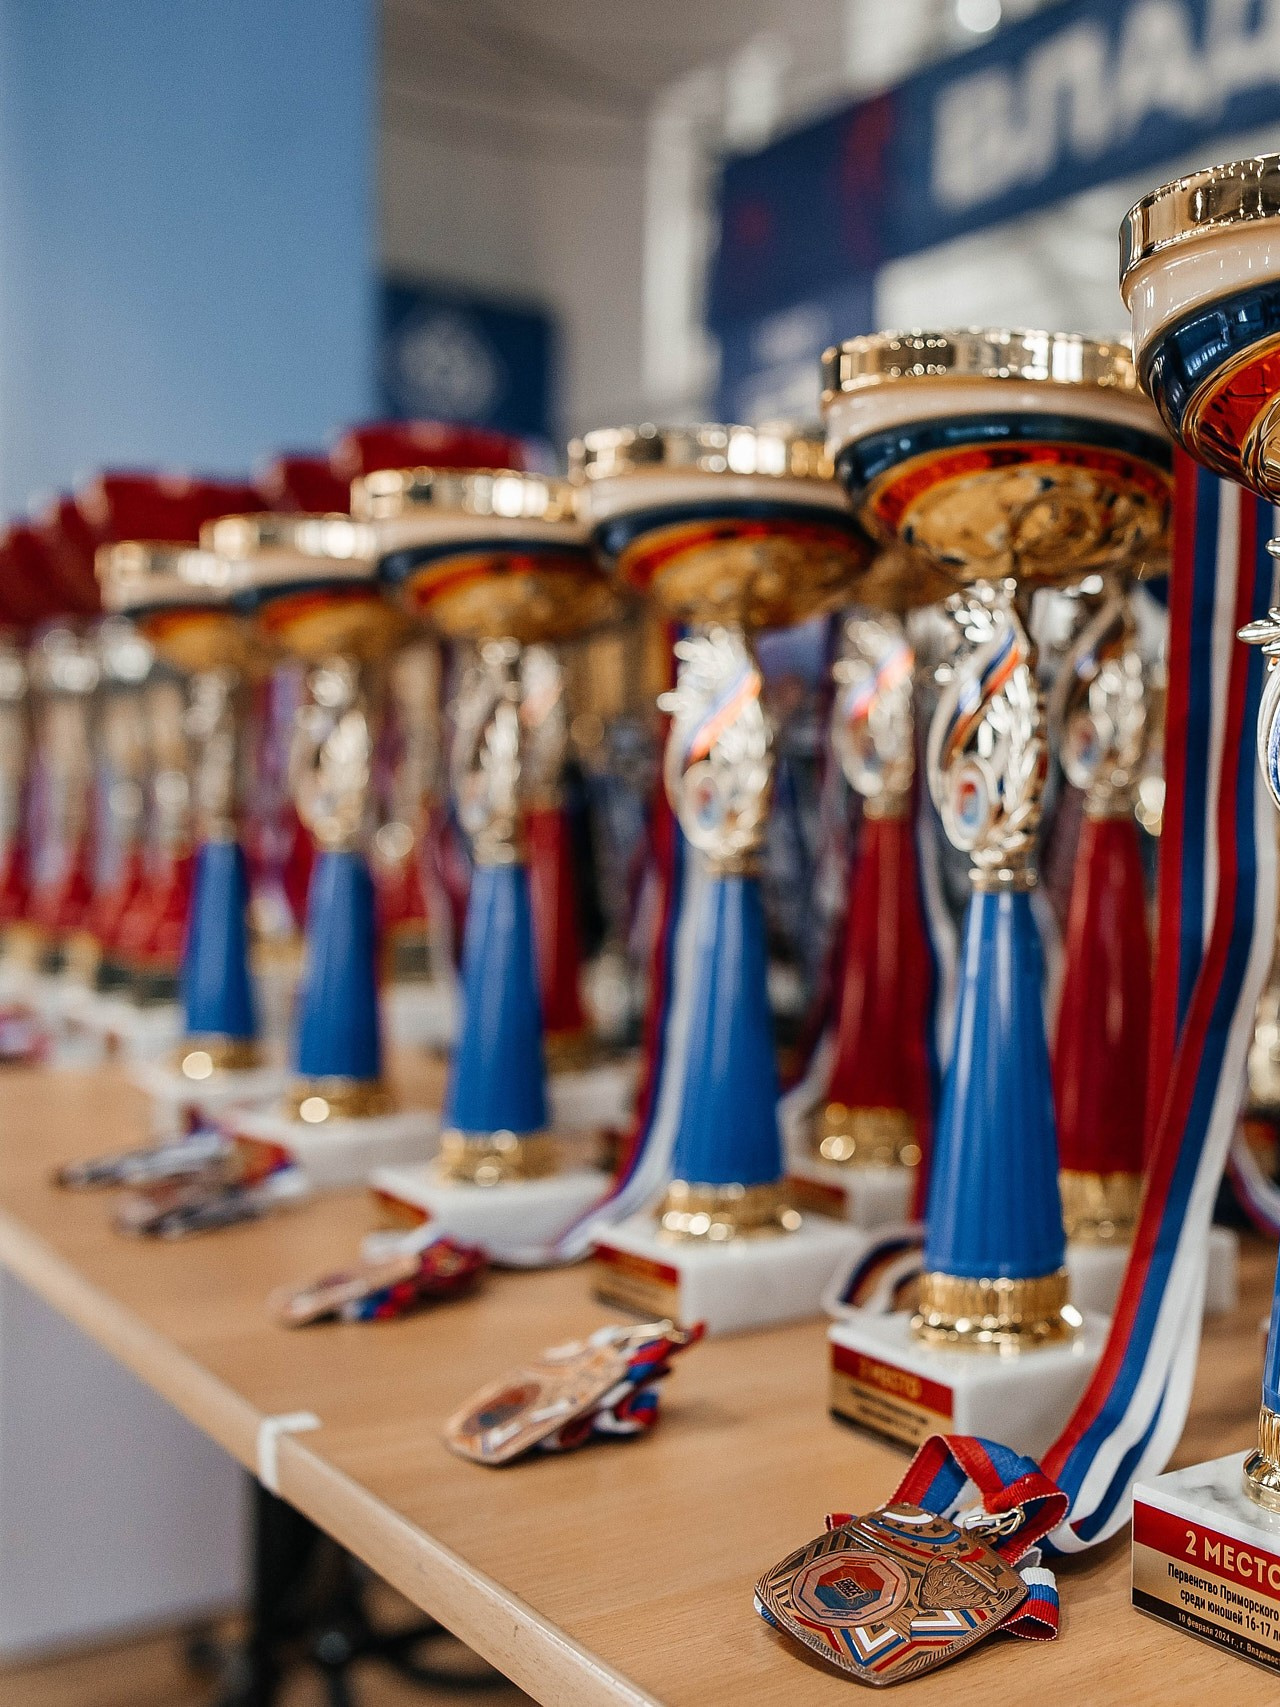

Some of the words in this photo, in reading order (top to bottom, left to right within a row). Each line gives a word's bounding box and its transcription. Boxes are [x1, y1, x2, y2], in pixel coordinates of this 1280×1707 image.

[1185, 1530, 1197, 1556] 2
[1168, 1562, 1218, 1596] Первенство
[1220, 1584, 1279, 1622] Приморского
[1178, 1612, 1186, 1623] 10
[1187, 1616, 1214, 1635] февраля
[1214, 1628, 1230, 1643] 2024
[1180, 1589, 1206, 1610] среди
[1208, 1600, 1243, 1626] юношей
[1245, 1615, 1271, 1638] 16-17
